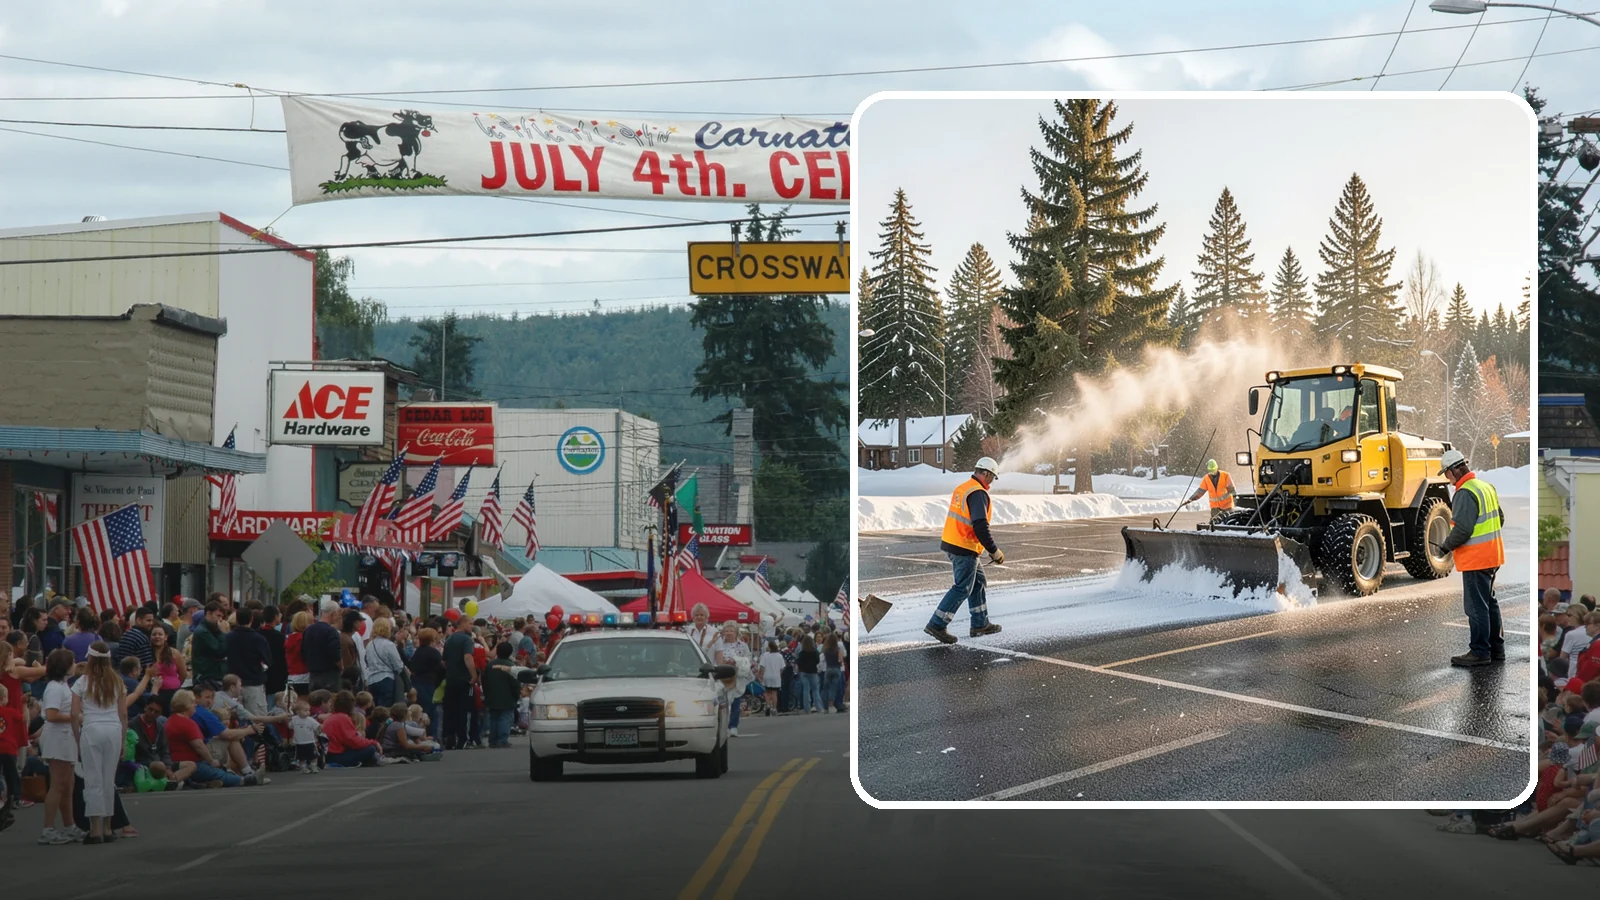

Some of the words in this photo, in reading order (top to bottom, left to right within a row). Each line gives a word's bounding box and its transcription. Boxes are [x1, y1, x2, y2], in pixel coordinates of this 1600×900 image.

[481, 141, 605, 192] JULY
[632, 150, 746, 198] 4th.
[697, 254, 850, 280] CROSSWA
[282, 380, 373, 420] ACE
[405, 409, 452, 422] CEDAR
[461, 409, 485, 422] LOG
[283, 421, 371, 436] Hardware
[416, 428, 477, 446] Coca-Cola
[353, 467, 384, 479] Simpl
[95, 485, 124, 494] Vincent
[126, 486, 136, 494] de
[137, 486, 155, 495] Paul
[212, 515, 330, 536] HARDARE
[688, 526, 741, 535] CRNATION
[699, 535, 730, 543] GLASS
